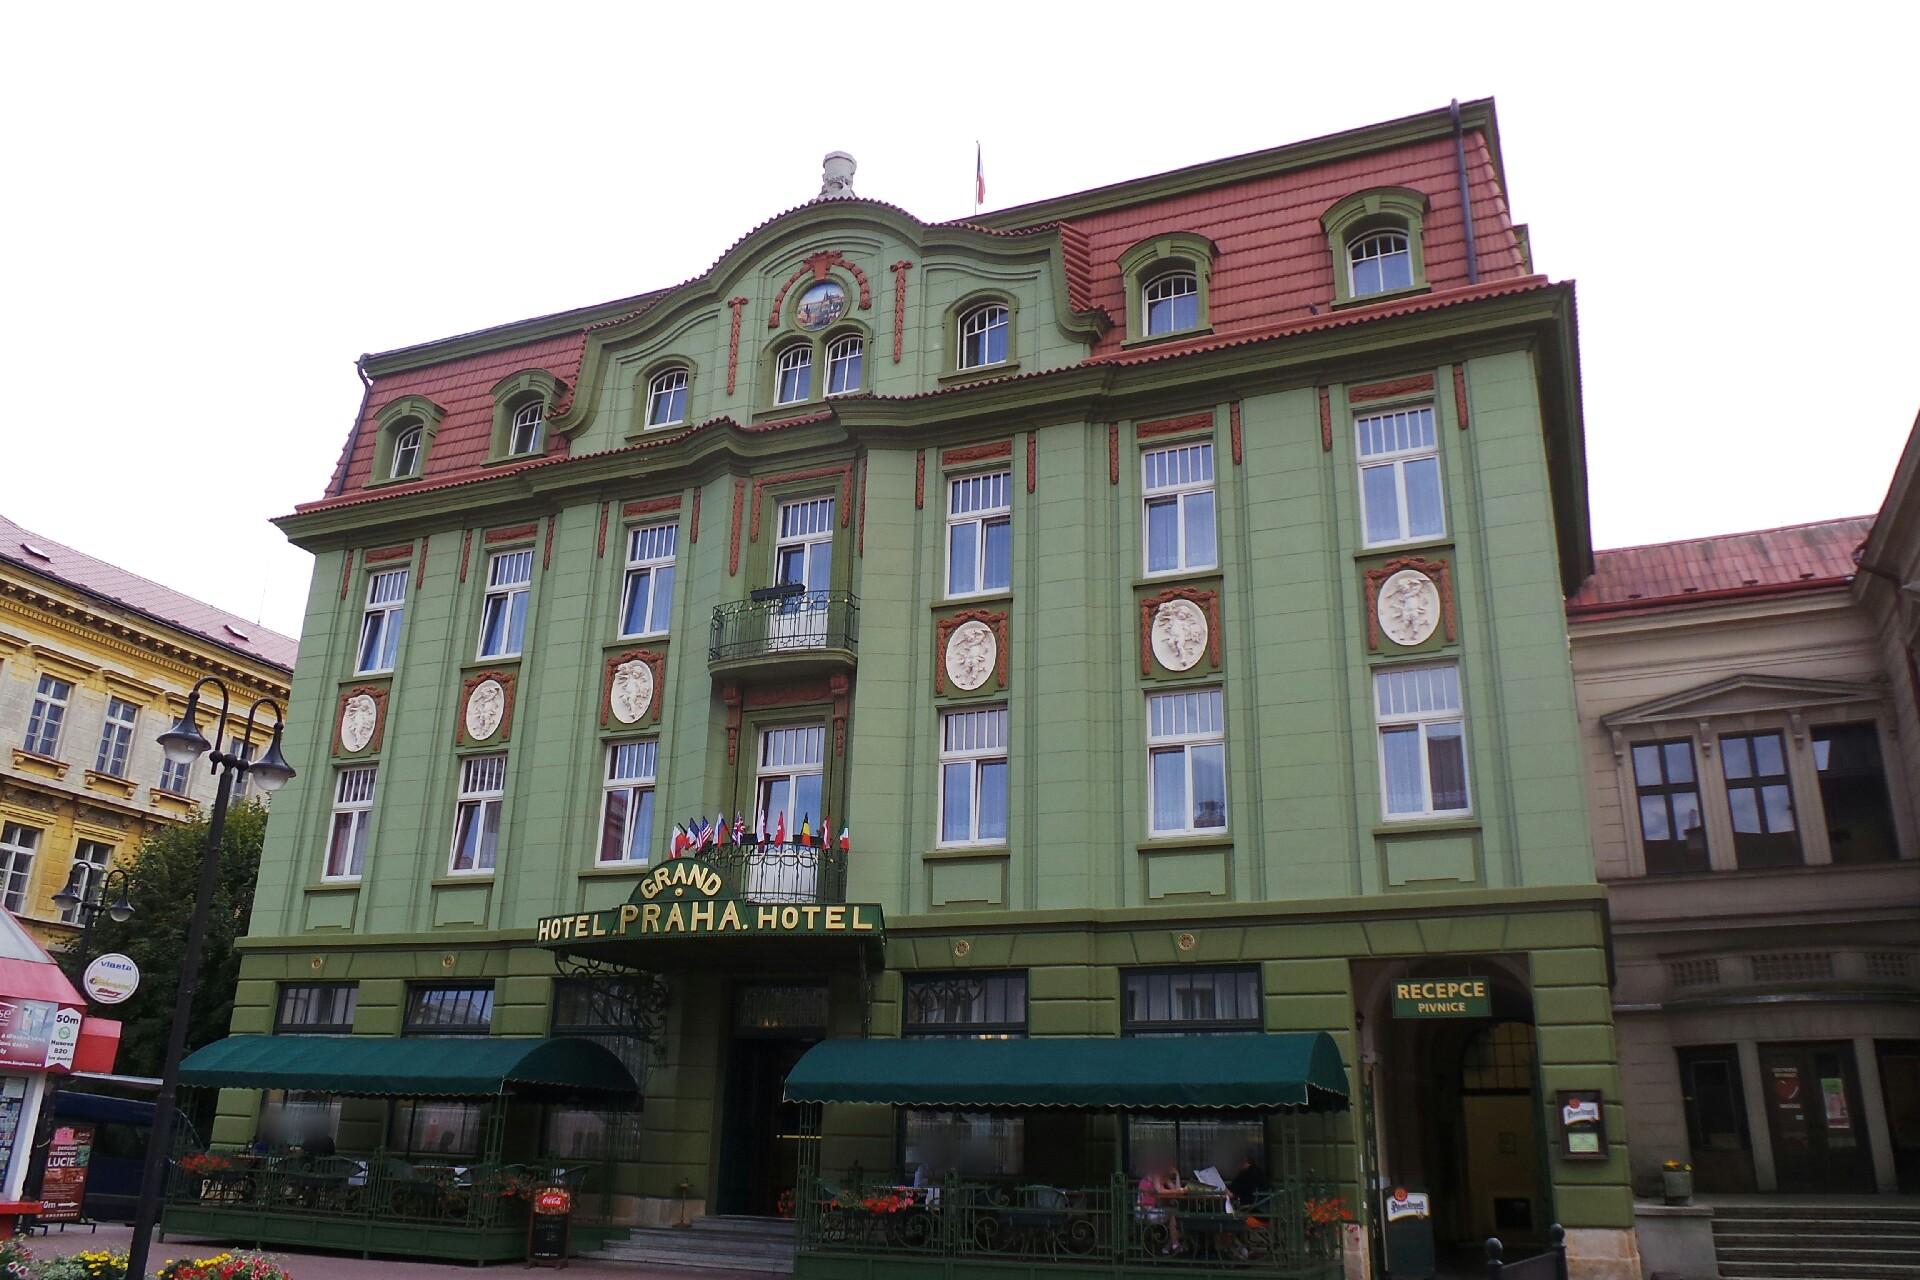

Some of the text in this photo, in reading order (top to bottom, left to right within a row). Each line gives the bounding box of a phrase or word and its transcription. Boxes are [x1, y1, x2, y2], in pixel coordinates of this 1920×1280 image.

[640, 862, 723, 899] GRAND
[757, 905, 873, 930] HOTEL
[1397, 982, 1485, 999] RECEPCE
[1417, 1002, 1466, 1013] PIVNICE
[56, 1014, 79, 1025] 50m
[47, 1157, 76, 1167] LUCIE
